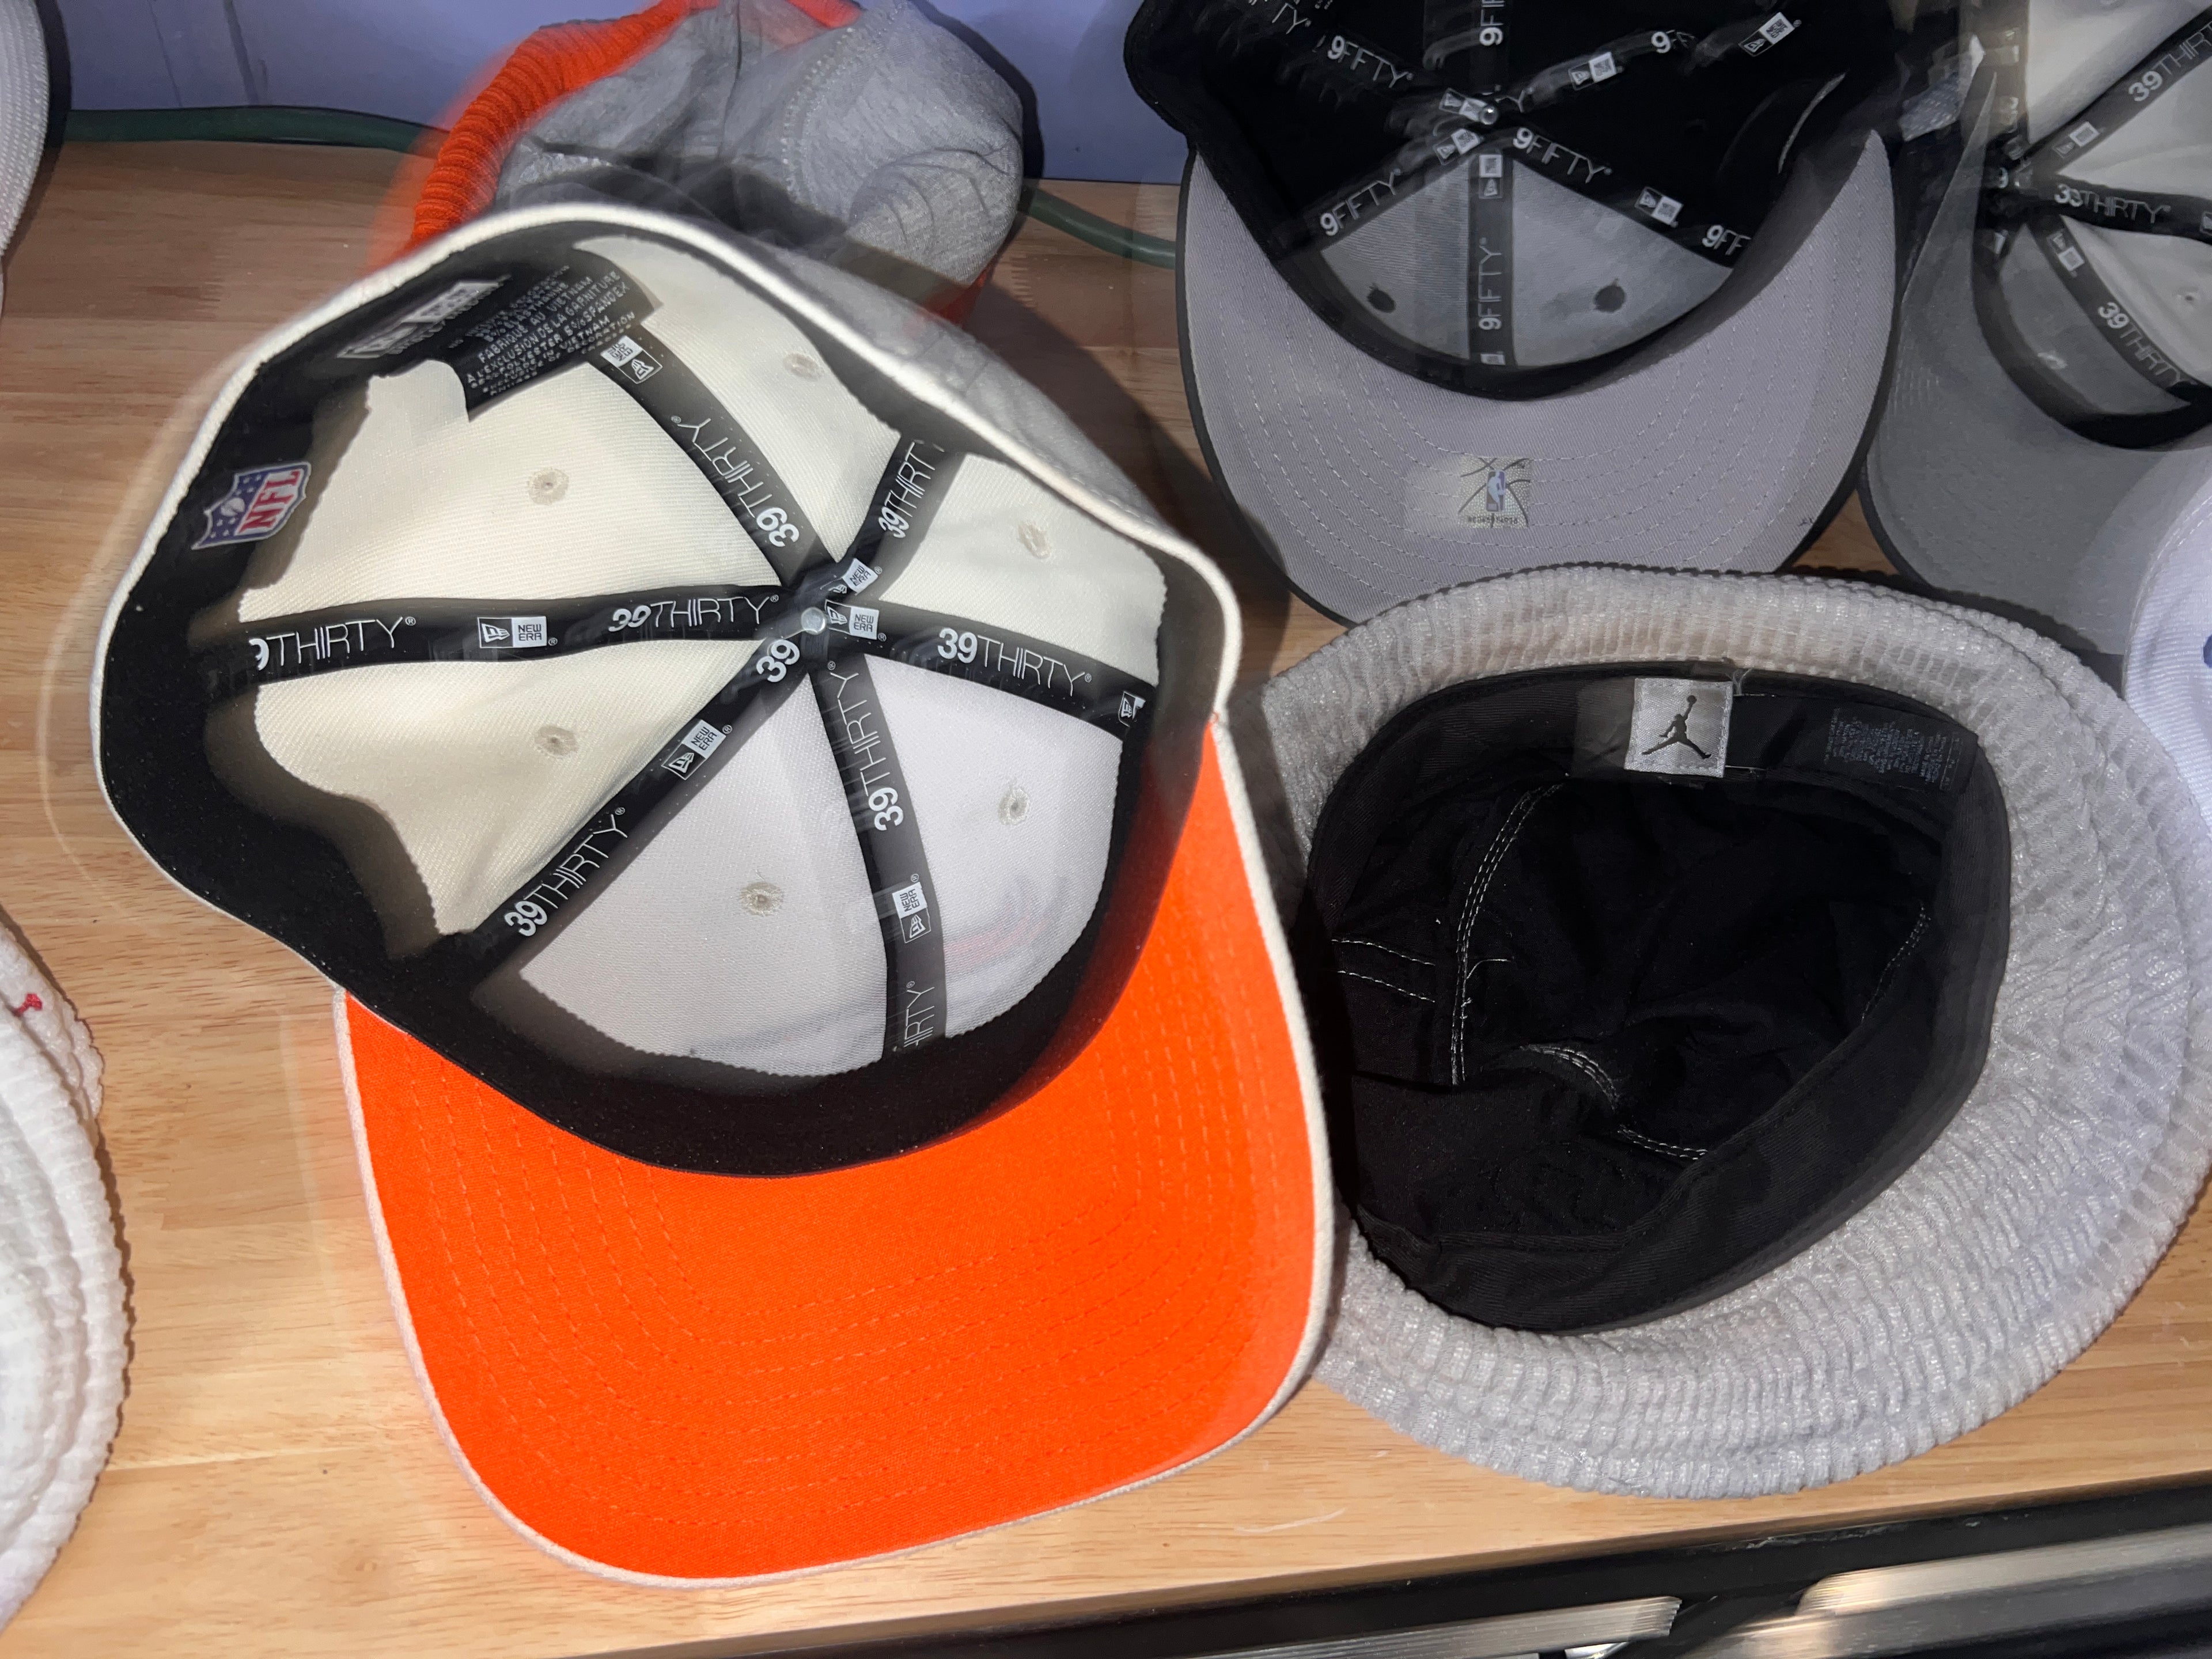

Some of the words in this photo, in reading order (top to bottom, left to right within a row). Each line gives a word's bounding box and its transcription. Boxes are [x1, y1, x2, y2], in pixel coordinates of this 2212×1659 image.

[878, 440, 944, 538] 39THIRT
[238, 470, 301, 534] NFL
[850, 565, 865, 583] NEW
[853, 571, 871, 586] ERA
[854, 622, 873, 632] ERA
[855, 614, 874, 624] NEW
[518, 624, 541, 633] NEW
[519, 633, 541, 641] ERA
[691, 726, 710, 746] NEW
[698, 732, 717, 751] ERA
[900, 892, 912, 912] NEW
[908, 889, 920, 908] ERA
